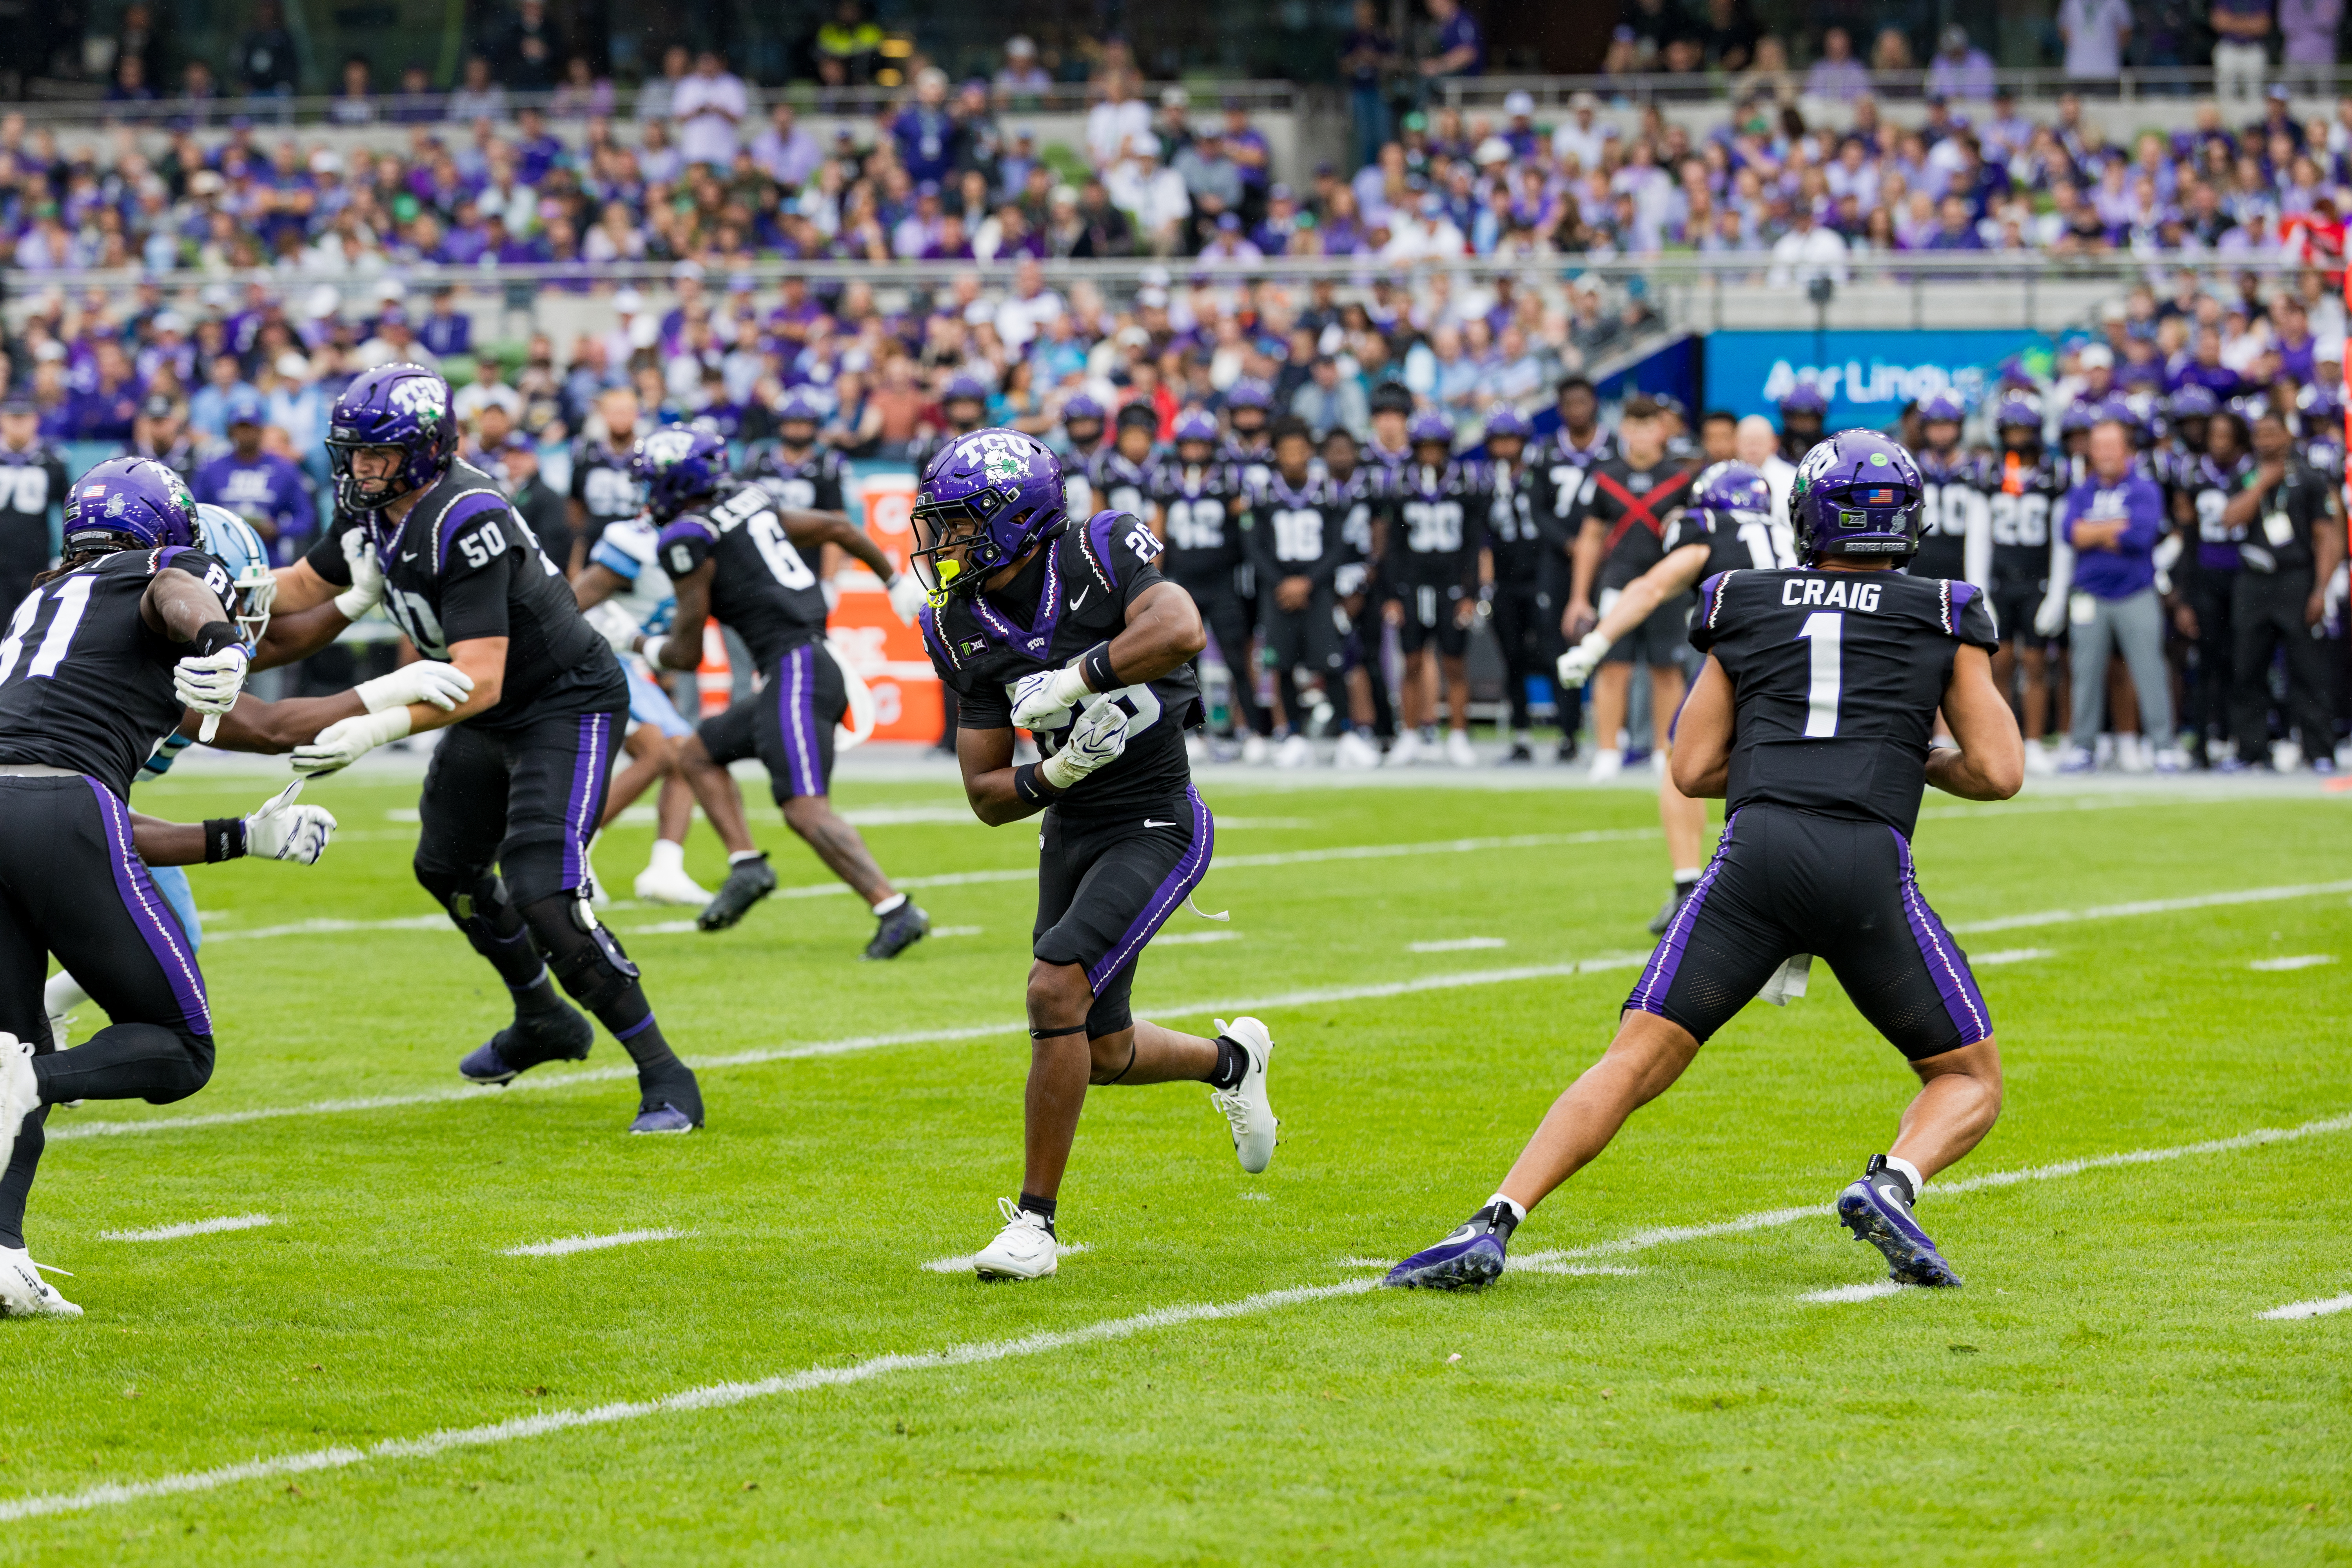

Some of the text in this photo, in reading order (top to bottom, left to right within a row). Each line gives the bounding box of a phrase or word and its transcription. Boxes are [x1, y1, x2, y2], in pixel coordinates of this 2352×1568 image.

[389, 377, 446, 416] TCU
[955, 433, 1032, 469] TCU
[459, 521, 506, 568] 50
[1124, 522, 1164, 566] 26
[1272, 509, 1323, 561] 16
[1402, 500, 1464, 553] 30
[670, 545, 694, 573] 6
[747, 510, 816, 591] 6
[1781, 579, 1882, 613] CRAIG
[970, 639, 987, 652] XII
[1027, 637, 1045, 651] TCU
[1795, 610, 1845, 737] 1
[31, 1287, 44, 1306] ZOOM
